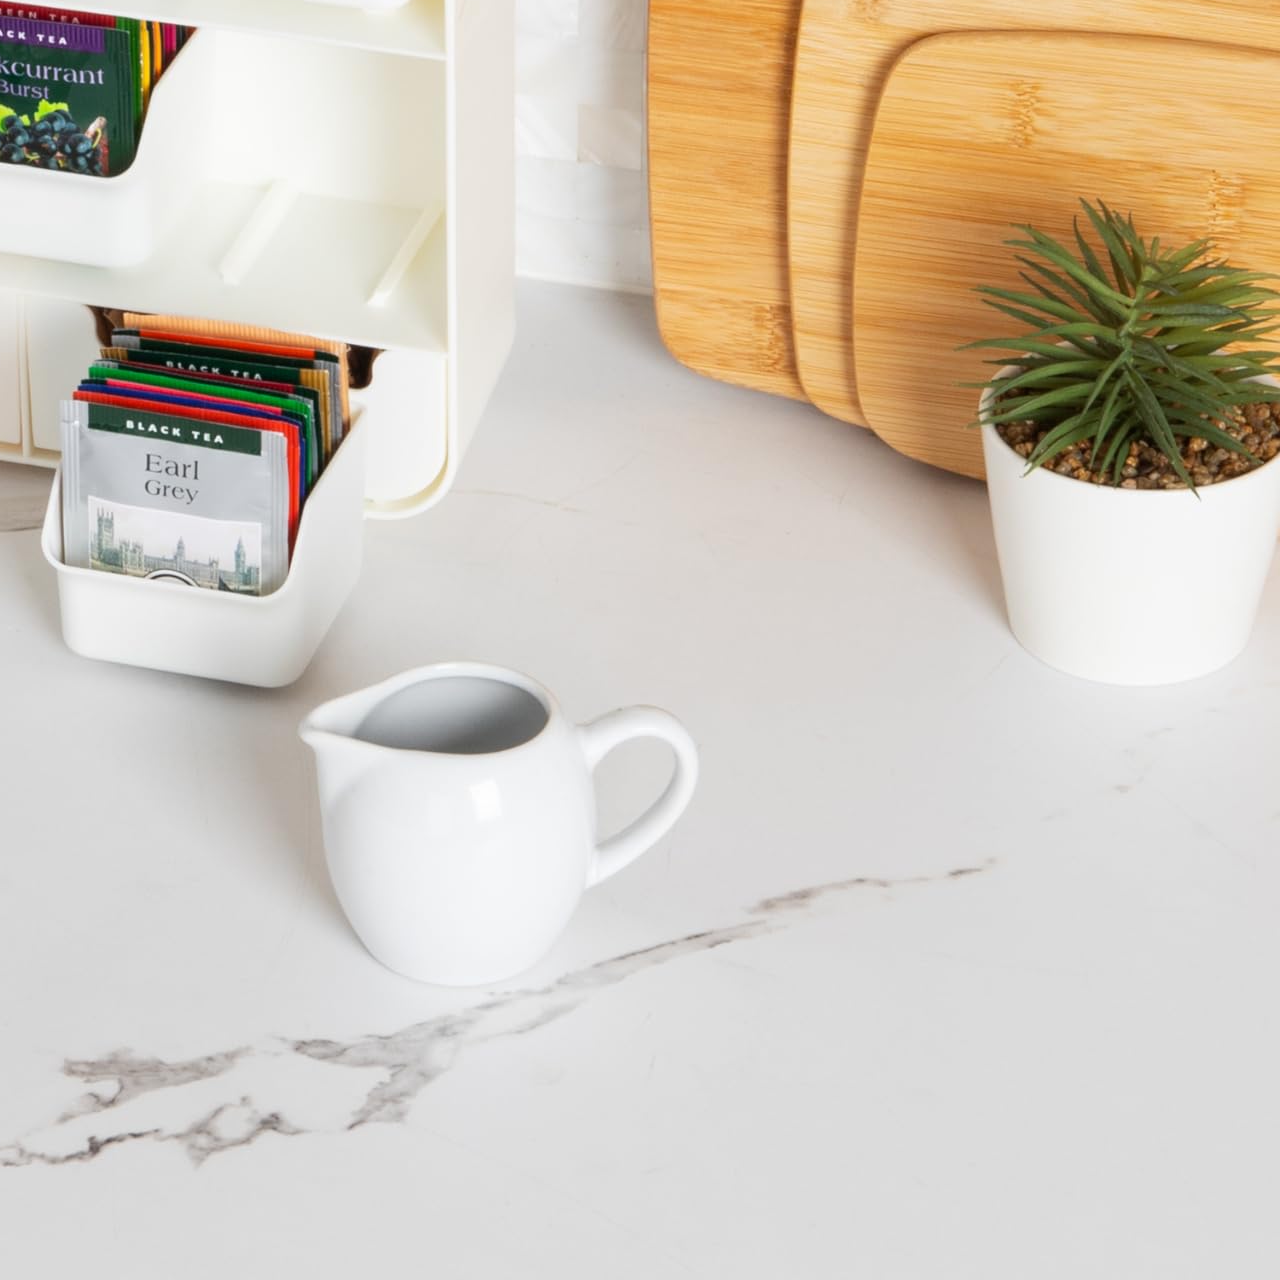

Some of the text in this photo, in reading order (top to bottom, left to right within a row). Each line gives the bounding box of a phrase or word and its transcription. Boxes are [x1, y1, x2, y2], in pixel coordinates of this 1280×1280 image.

[49, 13, 80, 24] TEA
[37, 34, 68, 46] TEA
[165, 360, 263, 381] BLACK TEA
[125, 420, 224, 444] BLACK TEA
[145, 453, 200, 480] Earl
[144, 479, 199, 504] Grey
